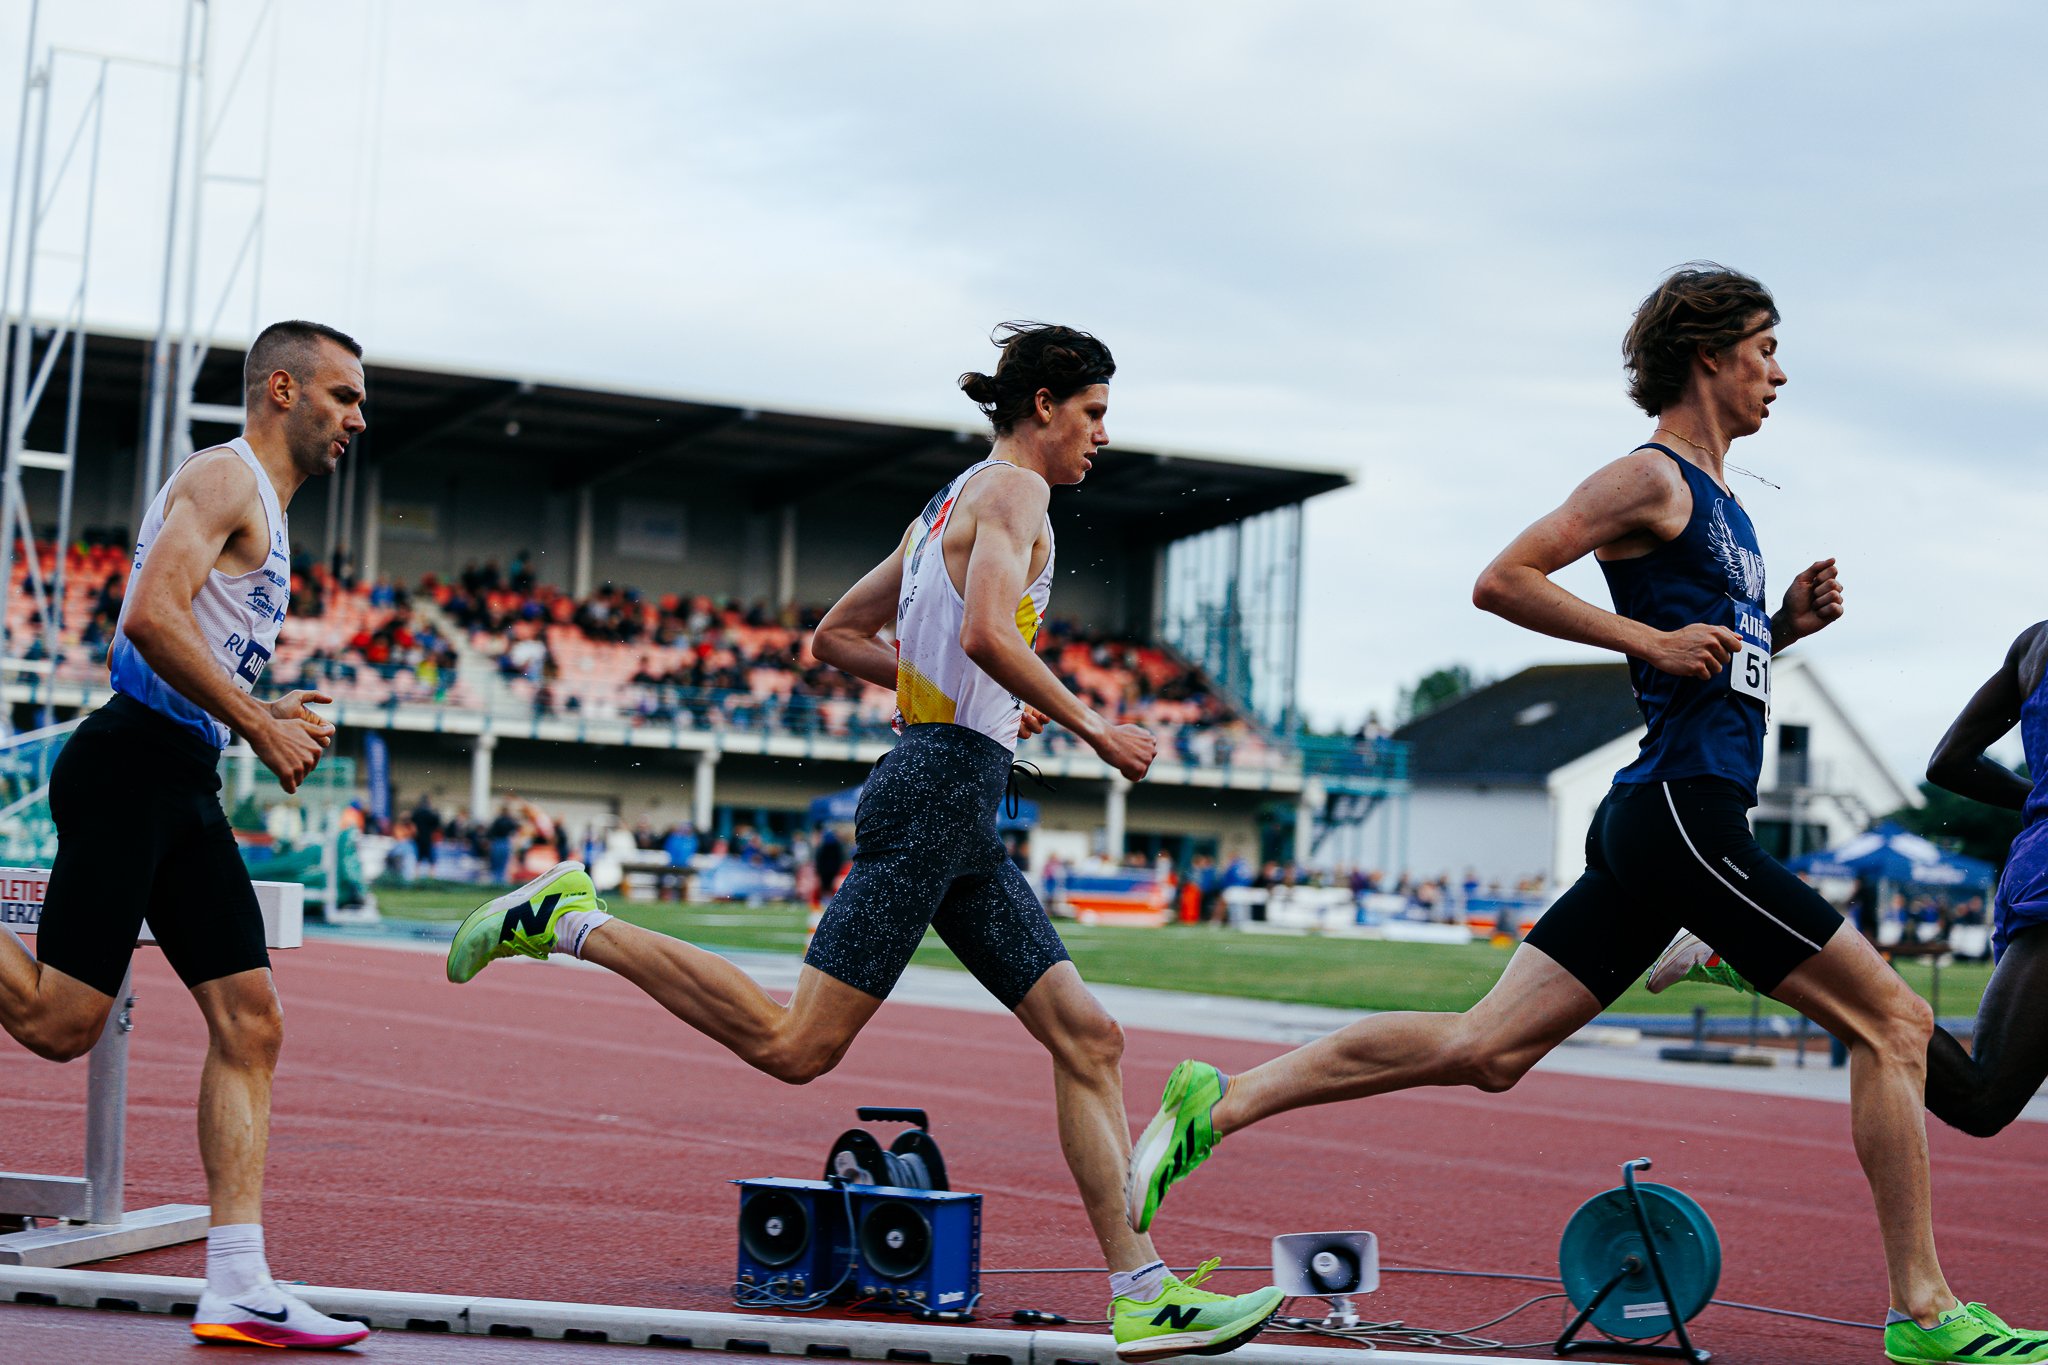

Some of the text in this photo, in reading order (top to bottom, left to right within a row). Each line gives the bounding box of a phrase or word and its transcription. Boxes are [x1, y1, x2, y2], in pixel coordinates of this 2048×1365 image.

[1745, 652, 1771, 695] 51
[1722, 856, 1750, 880] SALOMON
[1149, 1303, 1202, 1330] N
